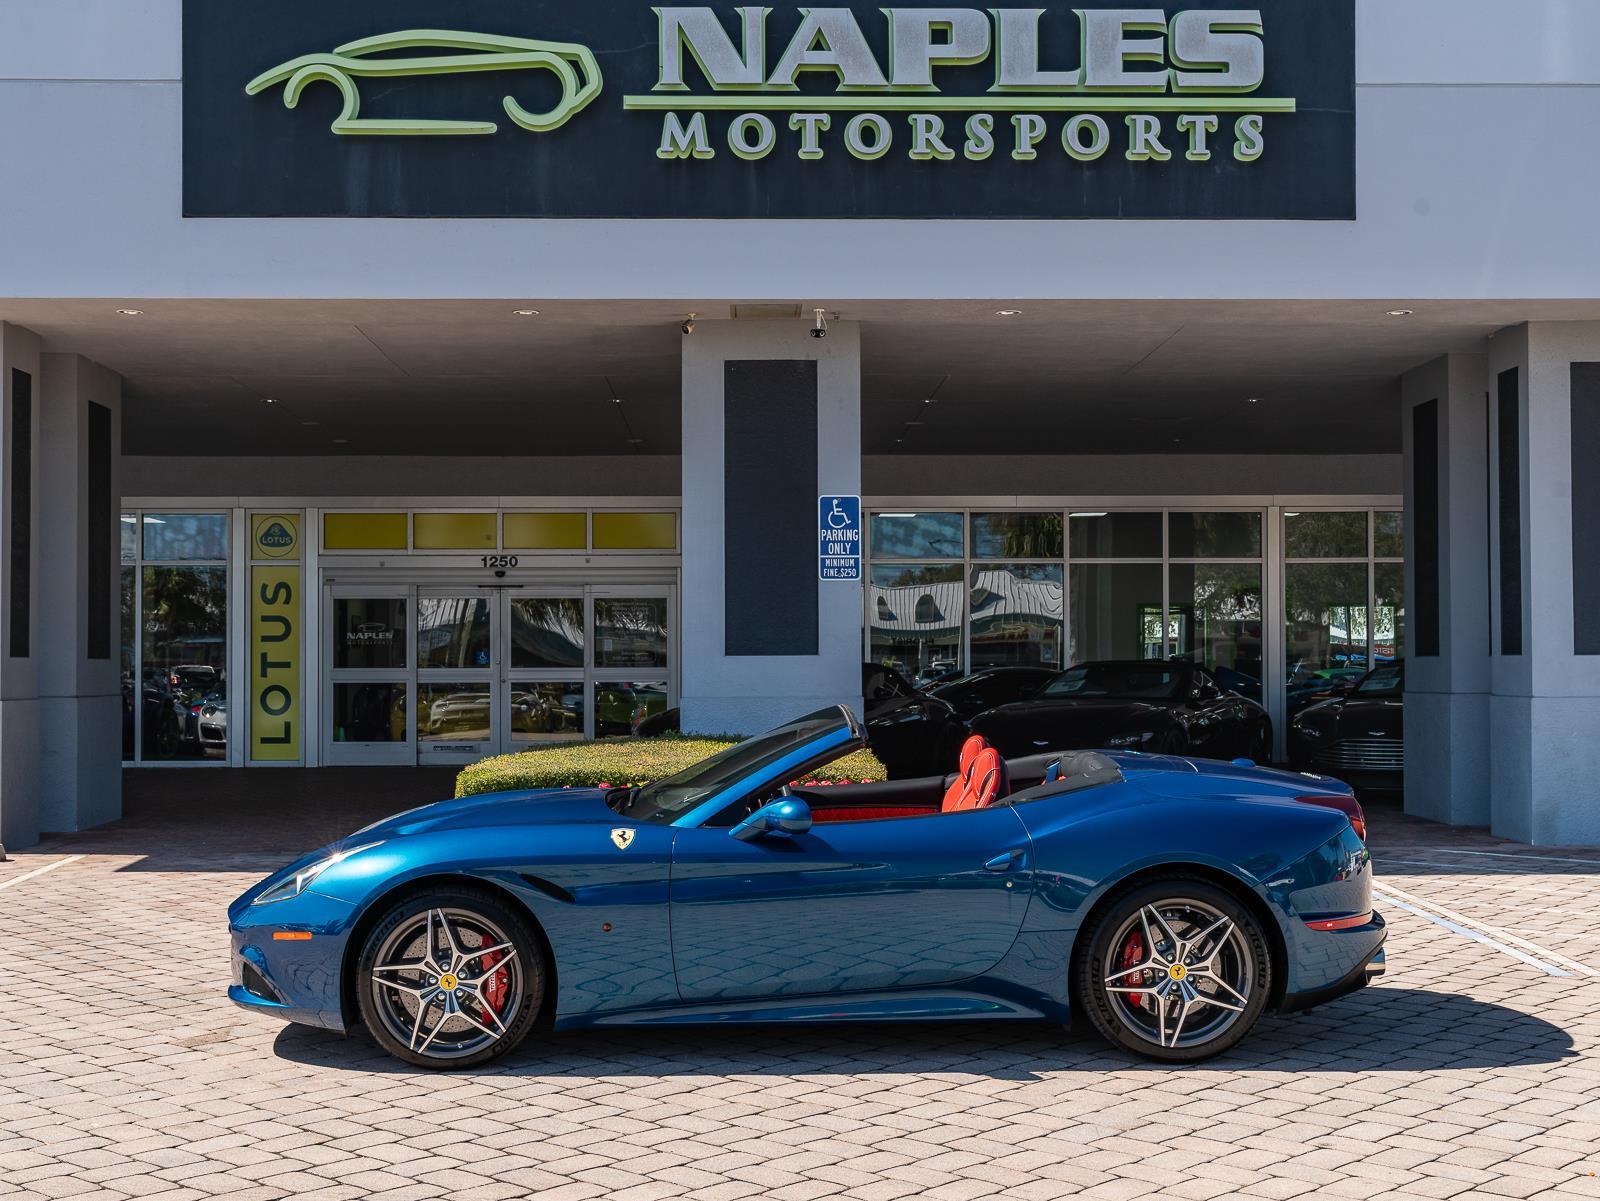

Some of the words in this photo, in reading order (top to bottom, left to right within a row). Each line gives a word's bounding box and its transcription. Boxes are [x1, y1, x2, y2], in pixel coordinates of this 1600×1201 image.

[651, 7, 1266, 93] NAPLES
[656, 111, 1265, 161] MOTORSPORTS
[261, 536, 292, 545] LOTUS
[820, 529, 859, 541] PARKING
[828, 542, 852, 555] ONLY
[481, 556, 519, 568] 1250
[825, 558, 855, 567] MINIMUM
[823, 568, 839, 577] FINE
[840, 567, 857, 578] $250
[346, 632, 393, 640] NAPLES
[260, 581, 293, 744] LOTUS
